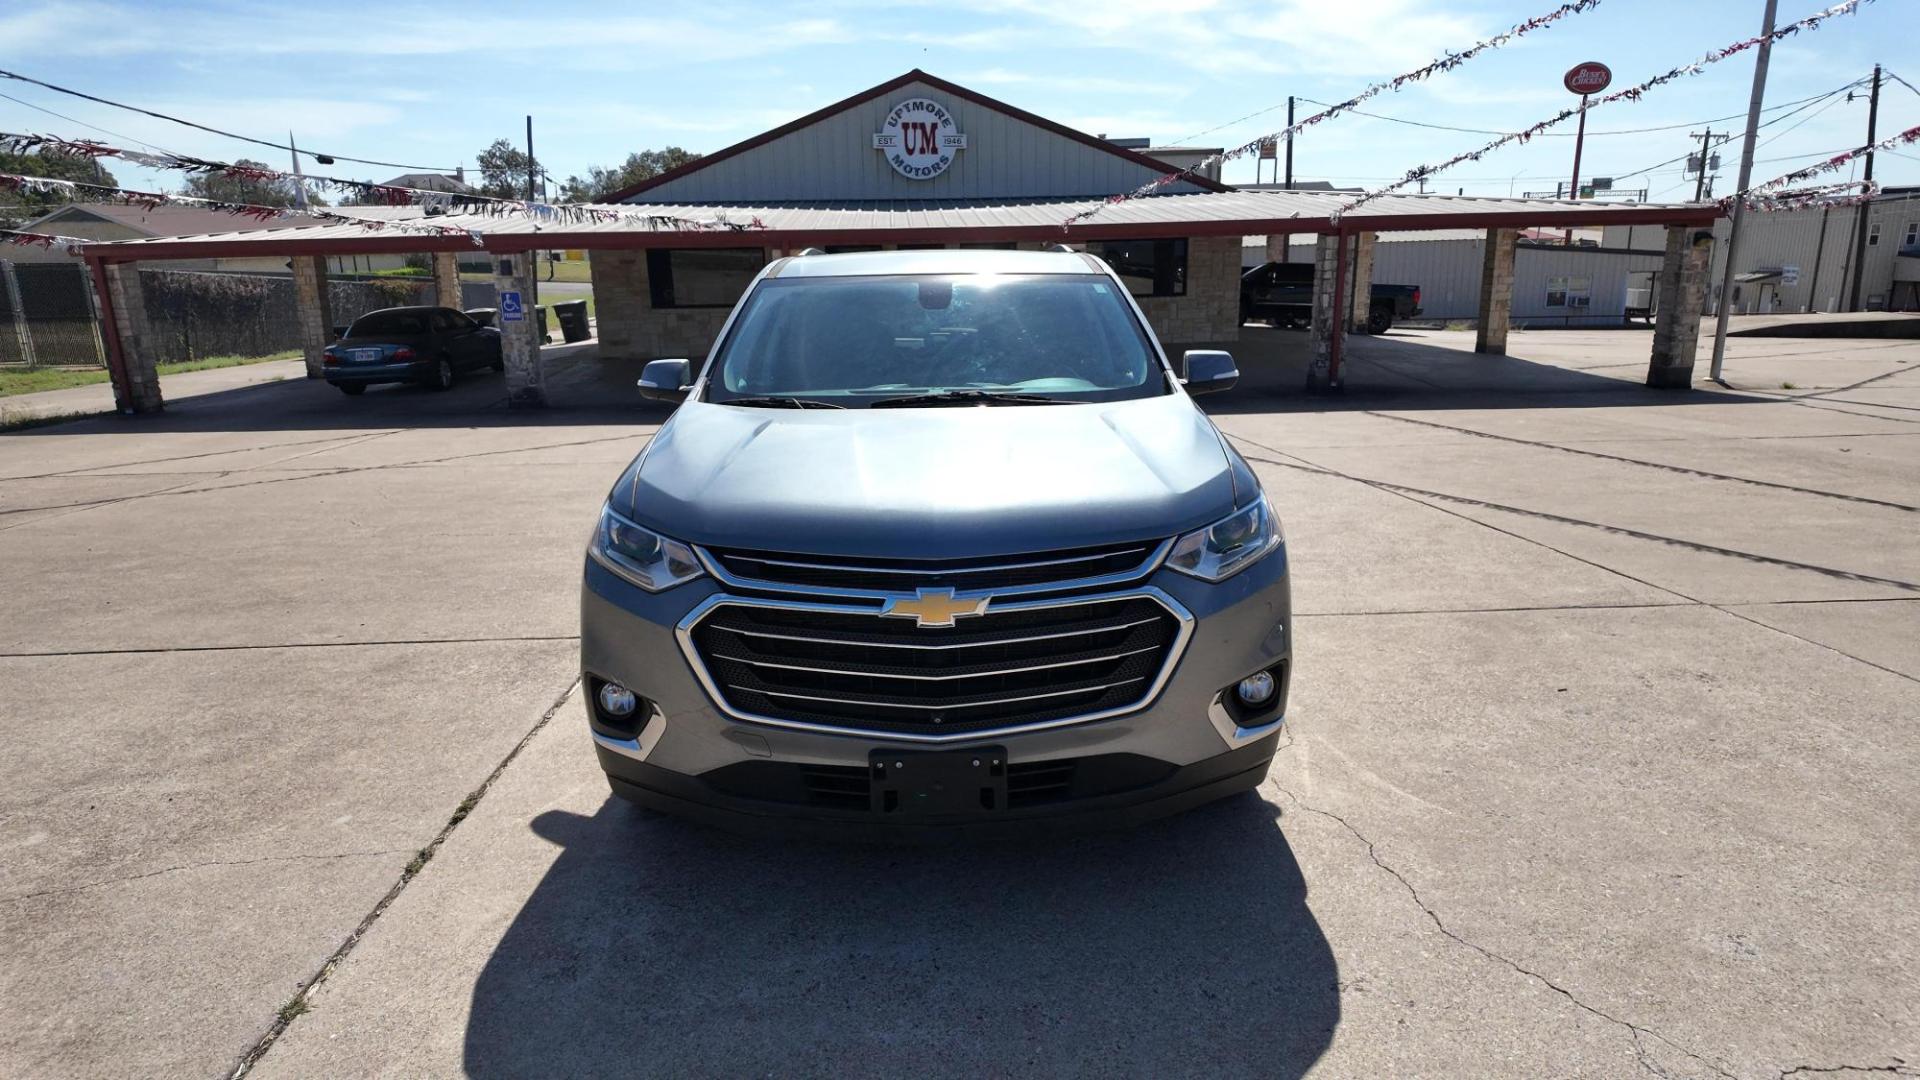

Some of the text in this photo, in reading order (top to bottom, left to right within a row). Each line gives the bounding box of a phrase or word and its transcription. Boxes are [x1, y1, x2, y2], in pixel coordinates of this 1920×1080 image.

[887, 101, 952, 128] UPTMORE
[878, 137, 895, 145] EST.
[901, 122, 939, 156] UM
[944, 137, 962, 145] 1946
[891, 153, 950, 177] MOTORS
